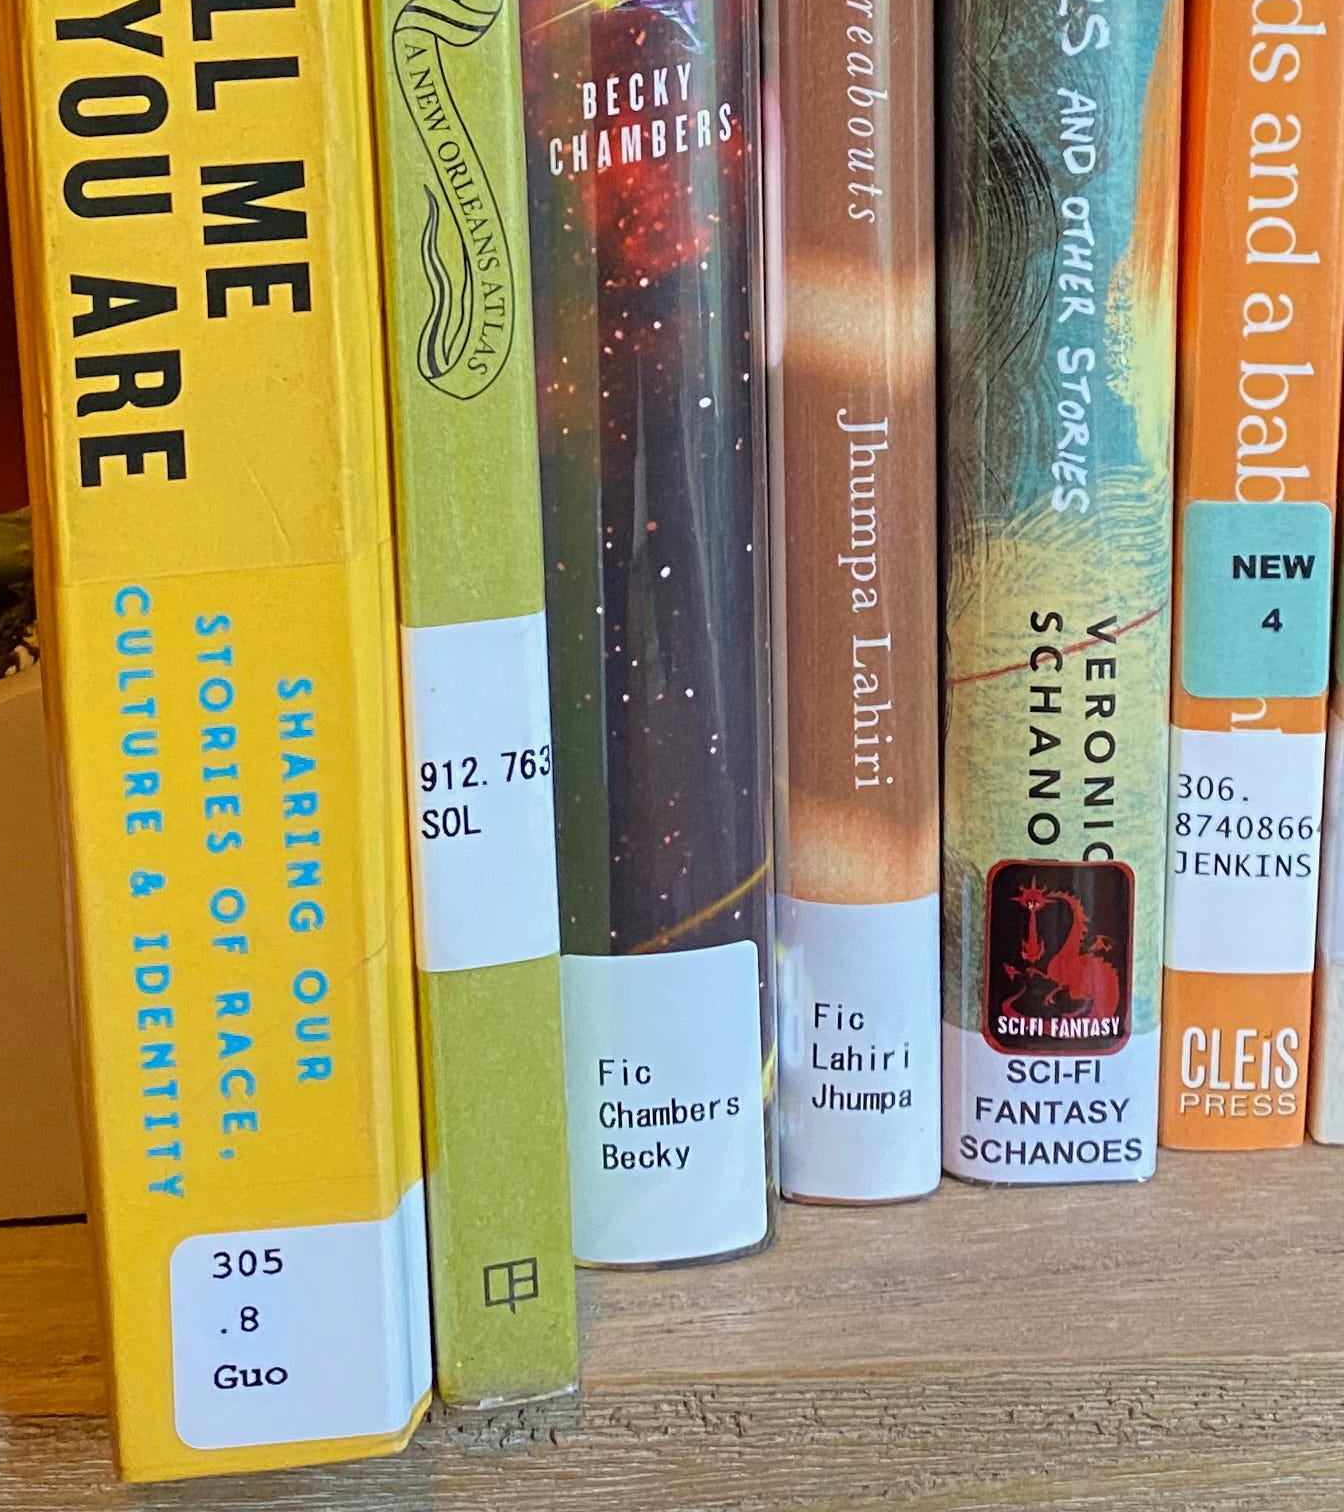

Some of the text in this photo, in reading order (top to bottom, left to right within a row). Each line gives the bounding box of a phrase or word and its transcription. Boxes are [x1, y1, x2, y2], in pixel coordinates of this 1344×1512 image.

[582, 62, 691, 120] BECKY
[548, 103, 732, 177] CHAMBERS
[1057, 87, 1097, 175] AND
[1245, 112, 1320, 266] and
[404, 43, 505, 375] A NEW ORLEANS ATLAS
[200, 160, 311, 319] ME
[1058, 196, 1095, 324] OTHER
[1242, 292, 1294, 337] a
[70, 274, 187, 488] ARE
[1051, 345, 1095, 515] STORIES
[1235, 361, 1315, 502] bab
[1232, 554, 1315, 580] NEW
[836, 407, 893, 790] Jhumpa Lahiri
[1262, 608, 1284, 633] 4
[1027, 610, 1064, 861] SCHANO
[1081, 615, 1118, 861] VERONIC
[1178, 773, 1249, 803] 306.
[422, 804, 482, 839] SOL
[1175, 812, 1322, 840] 8740866
[277, 677, 333, 1082] SHARING OUR
[1174, 850, 1312, 878] JENKINS
[114, 586, 184, 1197] CULTURE & IDENTITY
[195, 613, 258, 1160] STORIES OF RACE,
[814, 1001, 865, 1031] Fic
[1050, 1016, 1120, 1039] FANTASY
[598, 1058, 652, 1086] Fic
[813, 1041, 911, 1073] Lahiri
[1007, 1059, 1101, 1084] SCI-FI
[599, 1095, 741, 1129] Chambers
[812, 1083, 913, 1115] Jhumpa
[975, 1097, 1131, 1125] FANTASY
[1179, 1093, 1298, 1117] PRESS
[602, 1141, 690, 1170] Becky
[959, 1134, 1143, 1166] SCHANOES
[213, 1248, 283, 1279] 305
[213, 1364, 288, 1390] Guo
